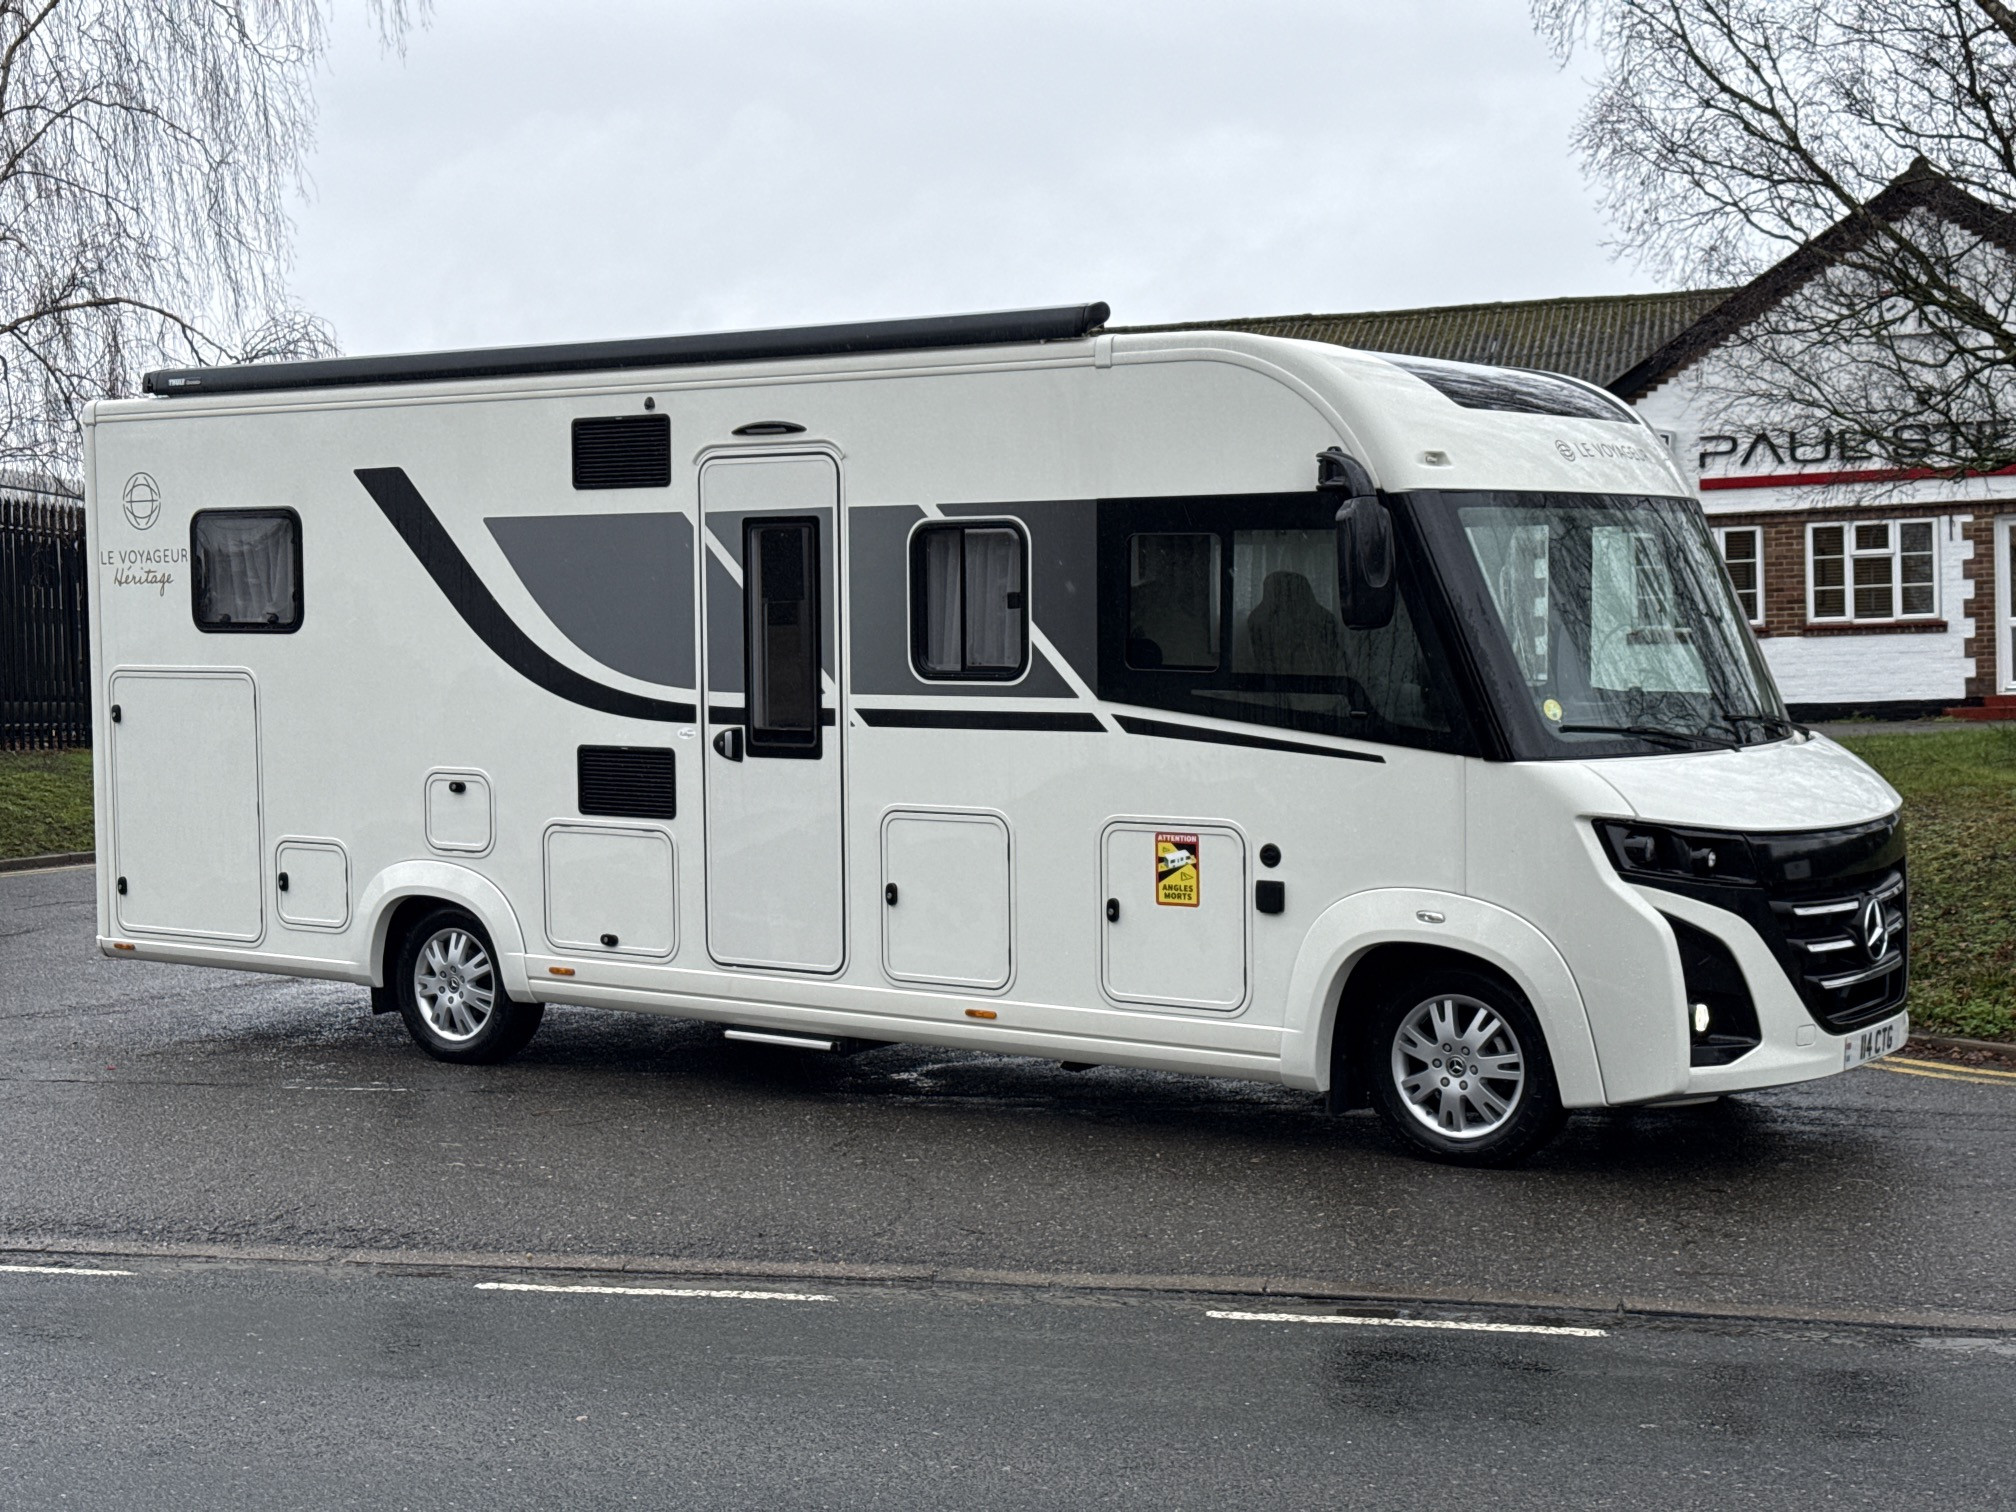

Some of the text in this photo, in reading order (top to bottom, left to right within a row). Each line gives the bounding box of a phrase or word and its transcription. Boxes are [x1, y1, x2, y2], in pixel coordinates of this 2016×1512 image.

[1573, 442, 1648, 462] LE VOYAGEUR
[100, 548, 188, 565] LE VOYAGEUR
[113, 565, 174, 597] Héritage
[1158, 834, 1197, 842] ATTENTION
[1162, 884, 1193, 892] ANGLES
[1164, 892, 1192, 900] MORTS
